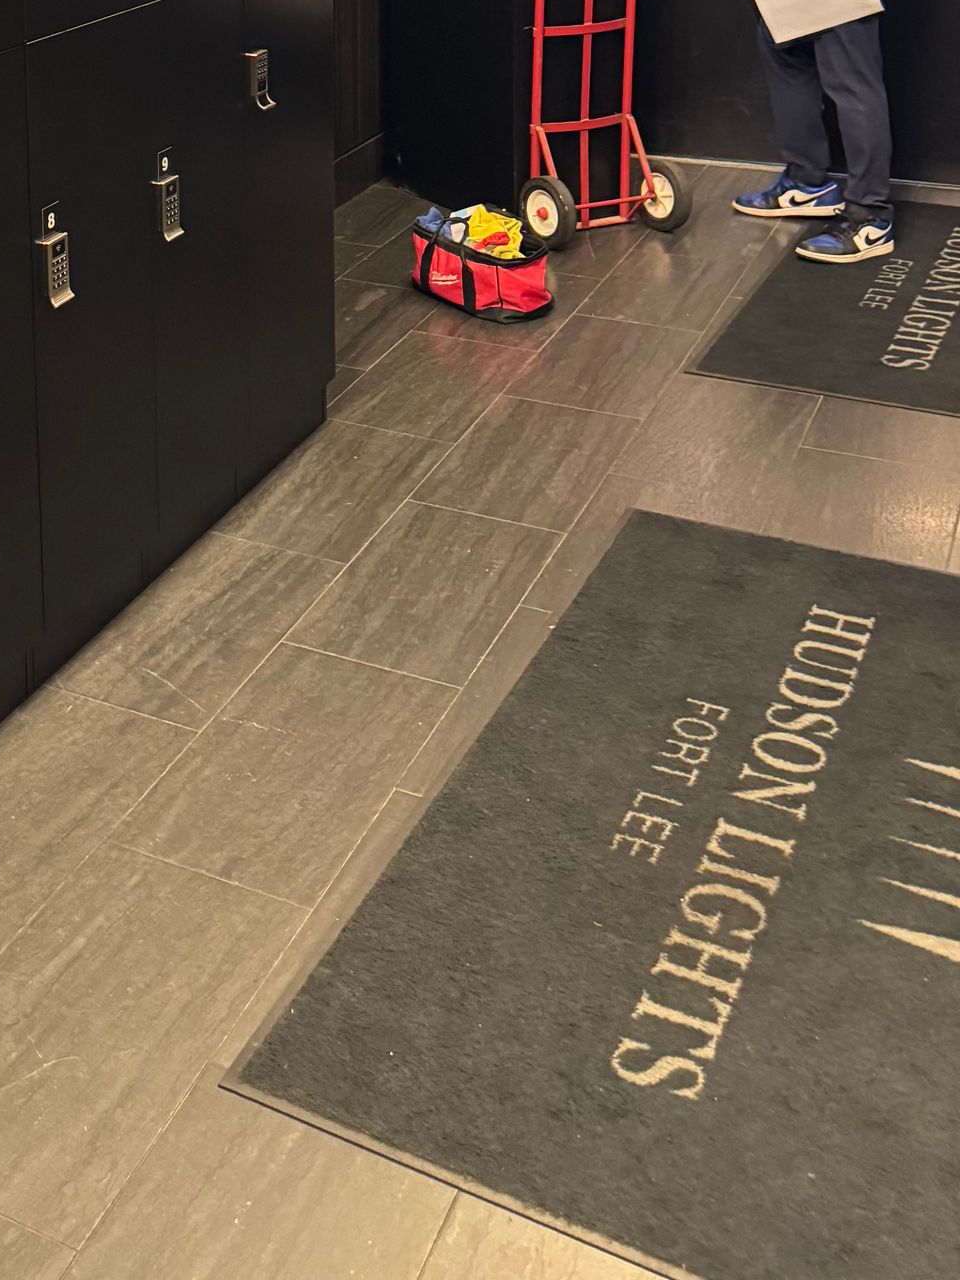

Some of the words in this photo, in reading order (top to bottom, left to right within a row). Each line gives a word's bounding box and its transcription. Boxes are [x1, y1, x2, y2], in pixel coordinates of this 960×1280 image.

[161, 156, 169, 172] 9
[47, 212, 56, 229] 8
[859, 287, 895, 311] LEE
[874, 258, 914, 287] FORT
[880, 294, 960, 371] LIGHTS
[651, 696, 730, 787] FORT
[730, 602, 876, 821] HUDSON
[609, 788, 685, 866] LEE
[609, 816, 797, 1101] LIGHTS
